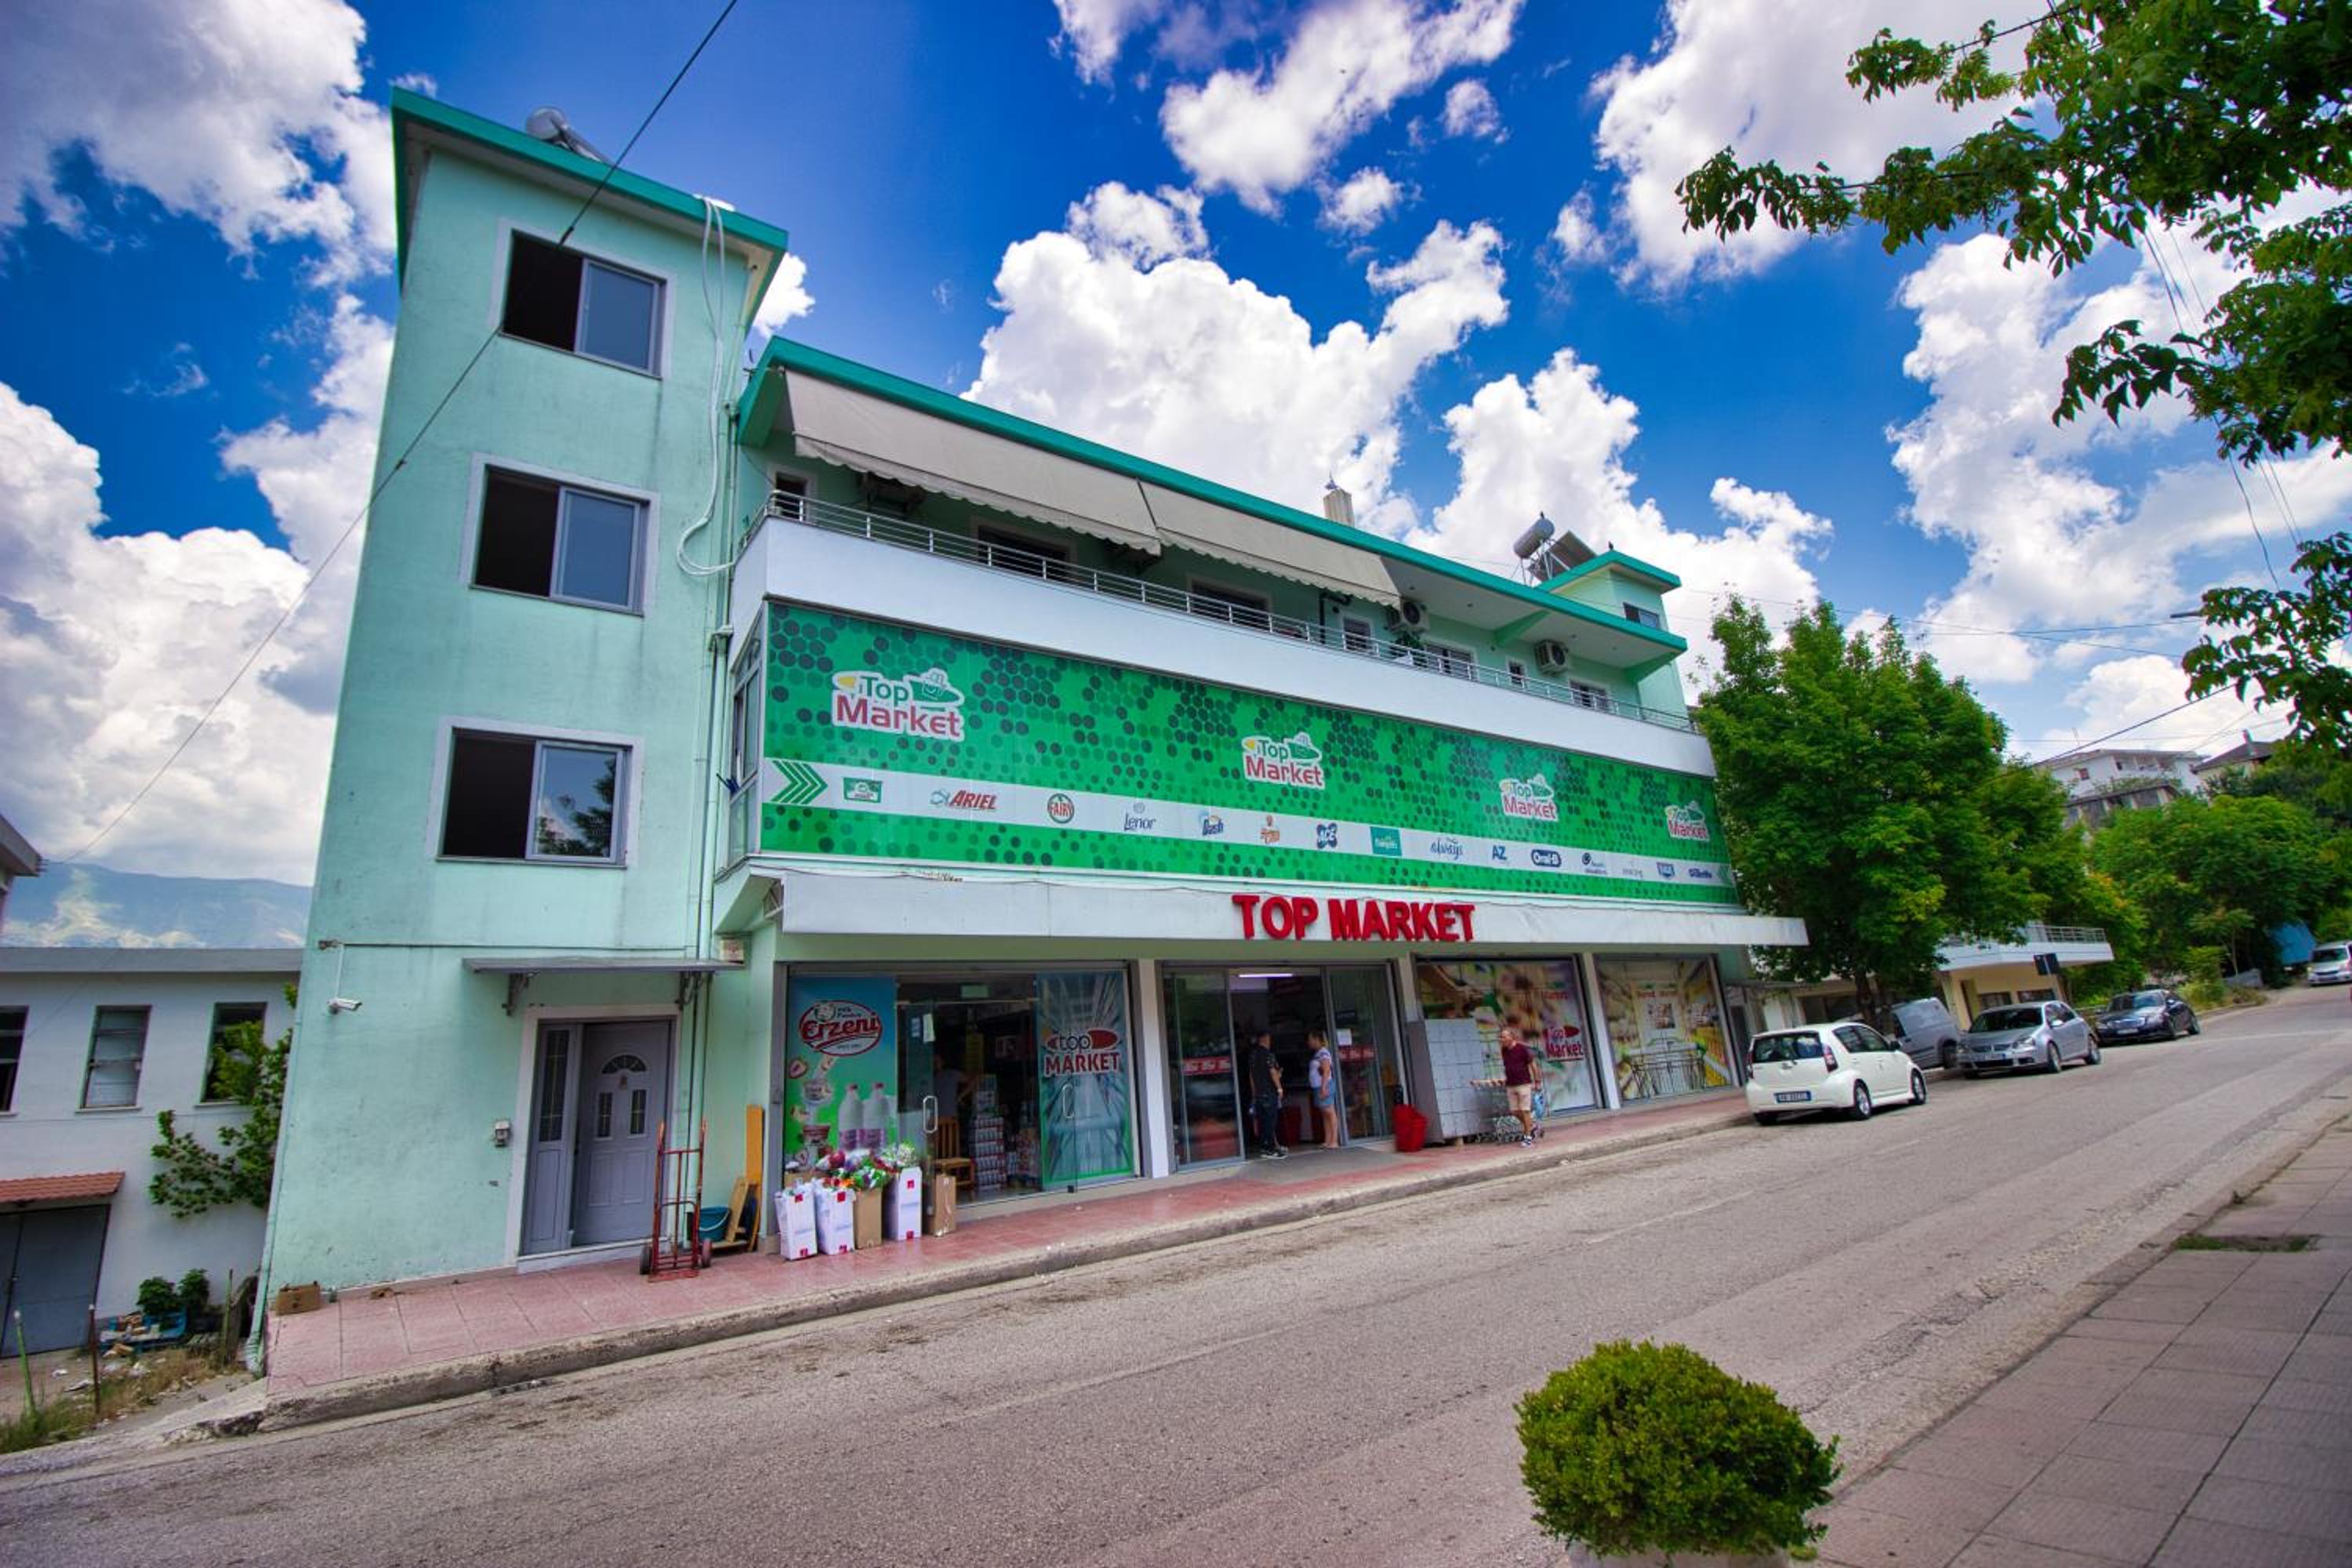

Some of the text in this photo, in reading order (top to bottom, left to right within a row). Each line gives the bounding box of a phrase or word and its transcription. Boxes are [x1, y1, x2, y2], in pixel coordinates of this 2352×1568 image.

[861, 676, 909, 706] Top
[837, 695, 961, 738] Market
[1258, 739, 1289, 763] Top
[1245, 755, 1323, 786] Market
[949, 789, 998, 811] ARIEL
[1511, 782, 1531, 801] Top
[1047, 800, 1074, 817] FAIRY
[1504, 796, 1556, 819] Market
[1124, 812, 1156, 831] Lenor
[1318, 828, 1336, 842] ACE
[1430, 838, 1464, 859] always
[1492, 845, 1507, 860] AZ
[1232, 895, 1475, 941] TOP MARKET
[802, 1014, 880, 1040] Erzeni
[1546, 1040, 1584, 1058] Market
[1045, 1052, 1120, 1075] MARKET
